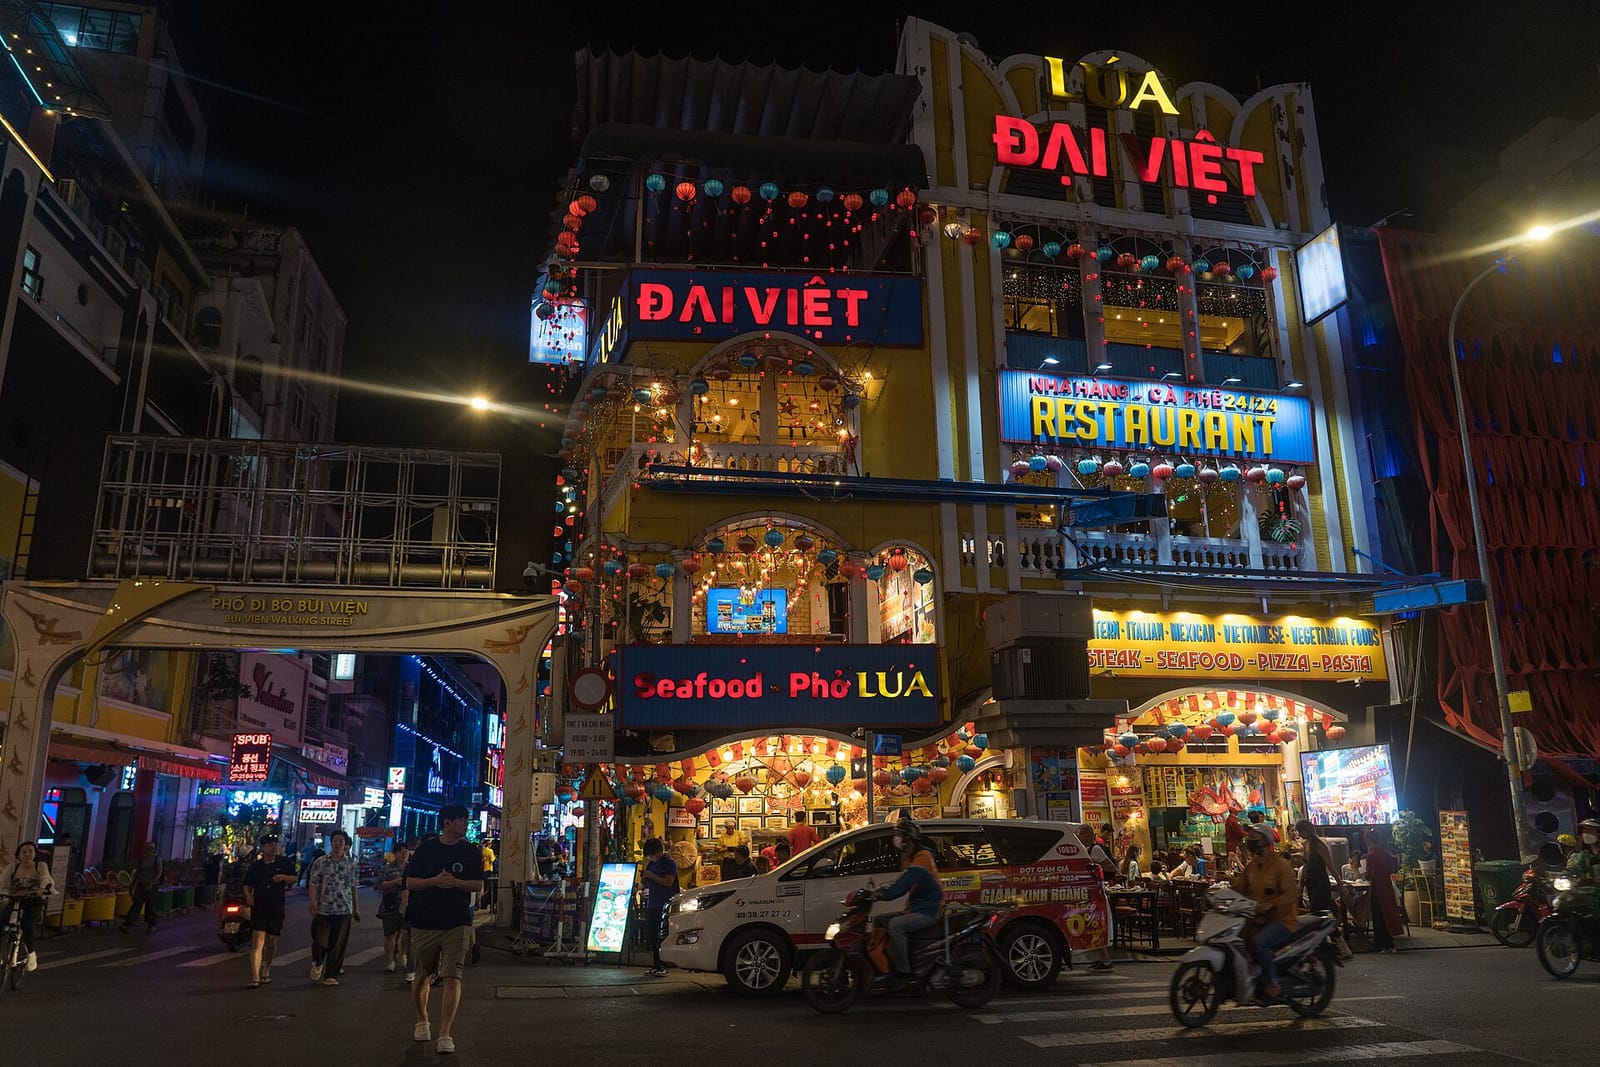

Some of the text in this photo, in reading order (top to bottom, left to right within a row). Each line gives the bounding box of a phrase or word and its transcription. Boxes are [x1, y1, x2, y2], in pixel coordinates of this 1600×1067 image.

[1044, 55, 1180, 115] LÚA
[992, 114, 1264, 205] ĐẠI VIỆT
[637, 276, 869, 339] ĐẠI VIỆT
[601, 296, 623, 364] LÚA
[1076, 378, 1129, 398] HÀNG
[1148, 384, 1178, 405] CÀ
[1184, 388, 1224, 408] PHÊ
[1224, 393, 1279, 413] 24/24
[1031, 395, 1277, 455] RESTAURANT
[211, 594, 246, 611] PHỐ
[250, 598, 266, 612] ĐI
[271, 597, 294, 614] BỘ
[329, 598, 369, 615] VIỆN
[271, 616, 318, 625] WALKING
[319, 616, 354, 626] STREET
[1126, 620, 1164, 641] ITALIAN
[1170, 622, 1216, 643] MEXICAN
[1223, 624, 1285, 645] VIETNAMESE
[1291, 626, 1349, 646] VEGETARIAN
[1350, 627, 1380, 647] FOODS
[1087, 648, 1373, 674] STEAK SEAFOOD PIZZA PASTA
[634, 671, 763, 699] Seafood
[789, 669, 853, 699] Phở
[857, 664, 934, 699] LÚA
[302, 810, 335, 821] TATTOO
[1022, 888, 1048, 902] KINH
